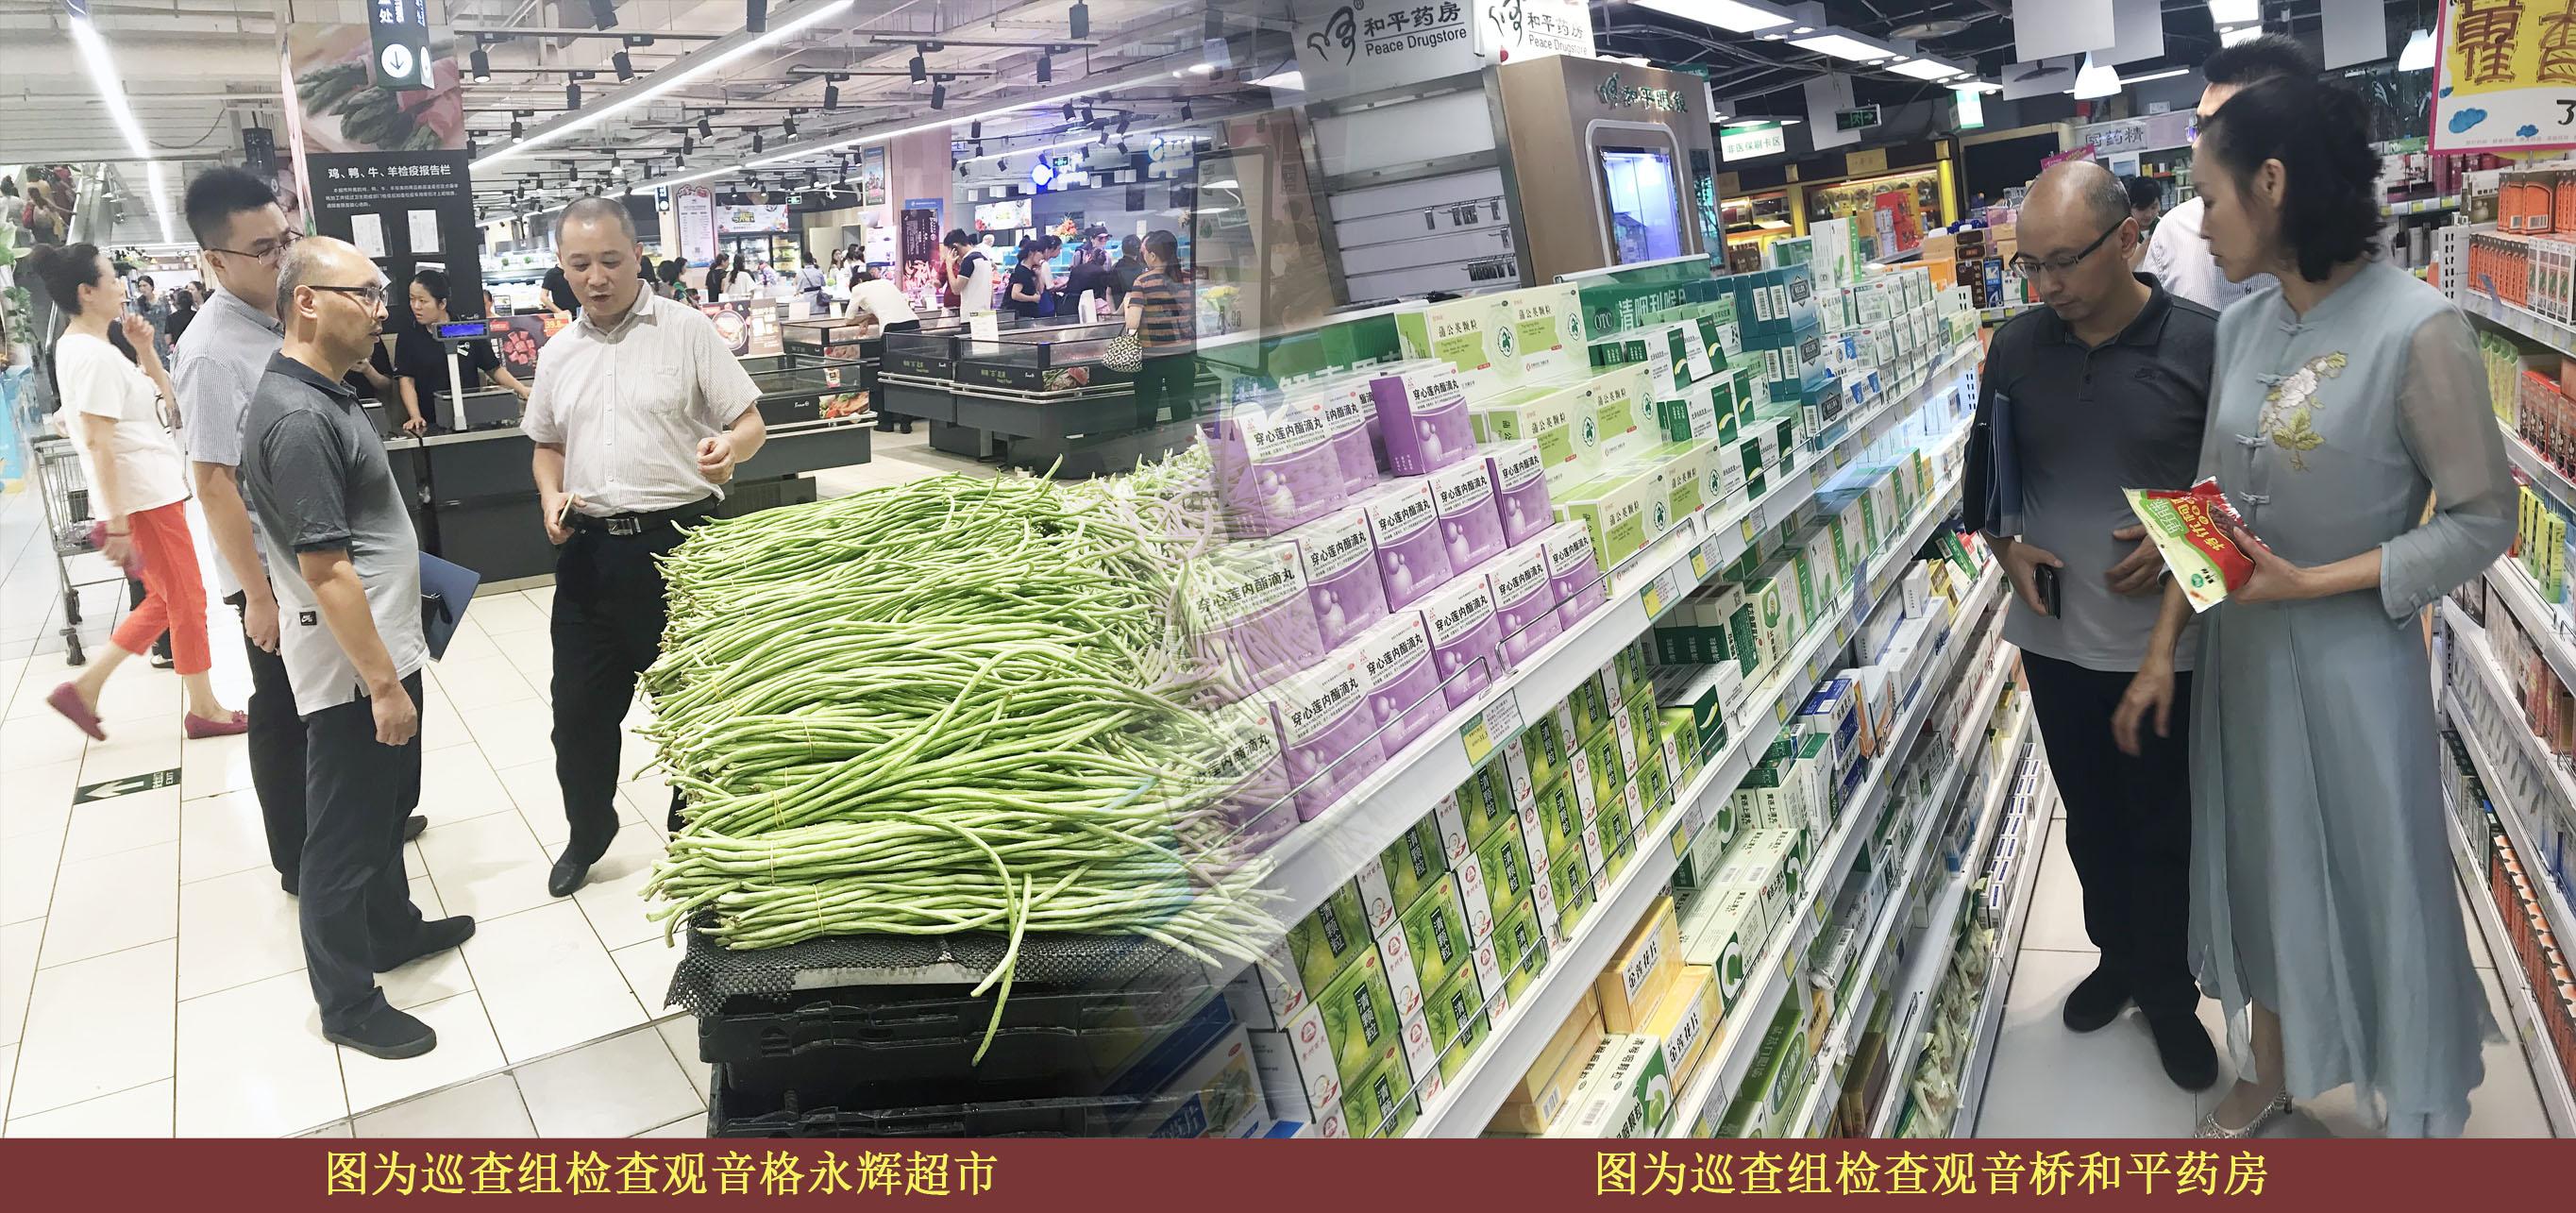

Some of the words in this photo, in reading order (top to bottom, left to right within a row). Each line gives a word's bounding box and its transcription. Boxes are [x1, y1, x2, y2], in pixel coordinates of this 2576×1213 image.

[1364, 2, 1461, 36] 和平药房
[1527, 12, 1584, 39] 和平药房
[1366, 41, 1404, 57] Peace
[1408, 27, 1467, 48] Drugstore
[1528, 34, 1553, 49] Peace
[1555, 40, 1588, 55] Drugstore
[1726, 136, 1781, 154] 非医保刷卡区
[328, 164, 451, 180] 鸡、鸭、牛、羊检疫报告栏
[1519, 305, 1551, 320] 蒲公英颗粒
[1593, 312, 1613, 329] OTC
[1439, 319, 1478, 338] 蒲公英颗粒
[1413, 379, 1459, 401] 穿心莲内酯滴丸
[1598, 388, 1626, 406] 蒲公英颗粒
[1254, 416, 1323, 446] 穿心莲内酯滴丸
[1532, 413, 1566, 434] 蒲公英颗粒
[1502, 454, 1540, 479] 穿心莲内酯滴丸
[1671, 467, 1697, 489] 蒲公英颗粒
[1440, 475, 1488, 503] 穿心莲内酯滴丸
[1378, 498, 1430, 531] 穿心莲内酯滴丸
[1609, 499, 1640, 527] 蒲公英颗粒
[1310, 531, 1368, 567] 穿心莲内酯滴丸
[1552, 536, 1589, 564] 穿心莲内酯滴丸
[1196, 568, 1296, 614] 穿心莲内酯滴丸
[1499, 564, 1544, 596] 穿心莲内酯滴丸
[1435, 595, 1489, 632] 穿心莲内酯滴丸
[1367, 632, 1424, 676] 穿心莲内酯滴丸
[1290, 677, 1359, 728] 穿心莲内酯滴丸
[1478, 767, 1495, 820] 一清颗粒
[1557, 791, 1571, 837] 一清颗粒
[1503, 844, 1519, 895] 一清颗粒
[1432, 909, 1452, 963] 一清颗粒
[1627, 941, 1658, 989] 金莲花片
[1355, 983, 1378, 1046] 一清颗粒
[1669, 1012, 1698, 1064] 金莲花片
